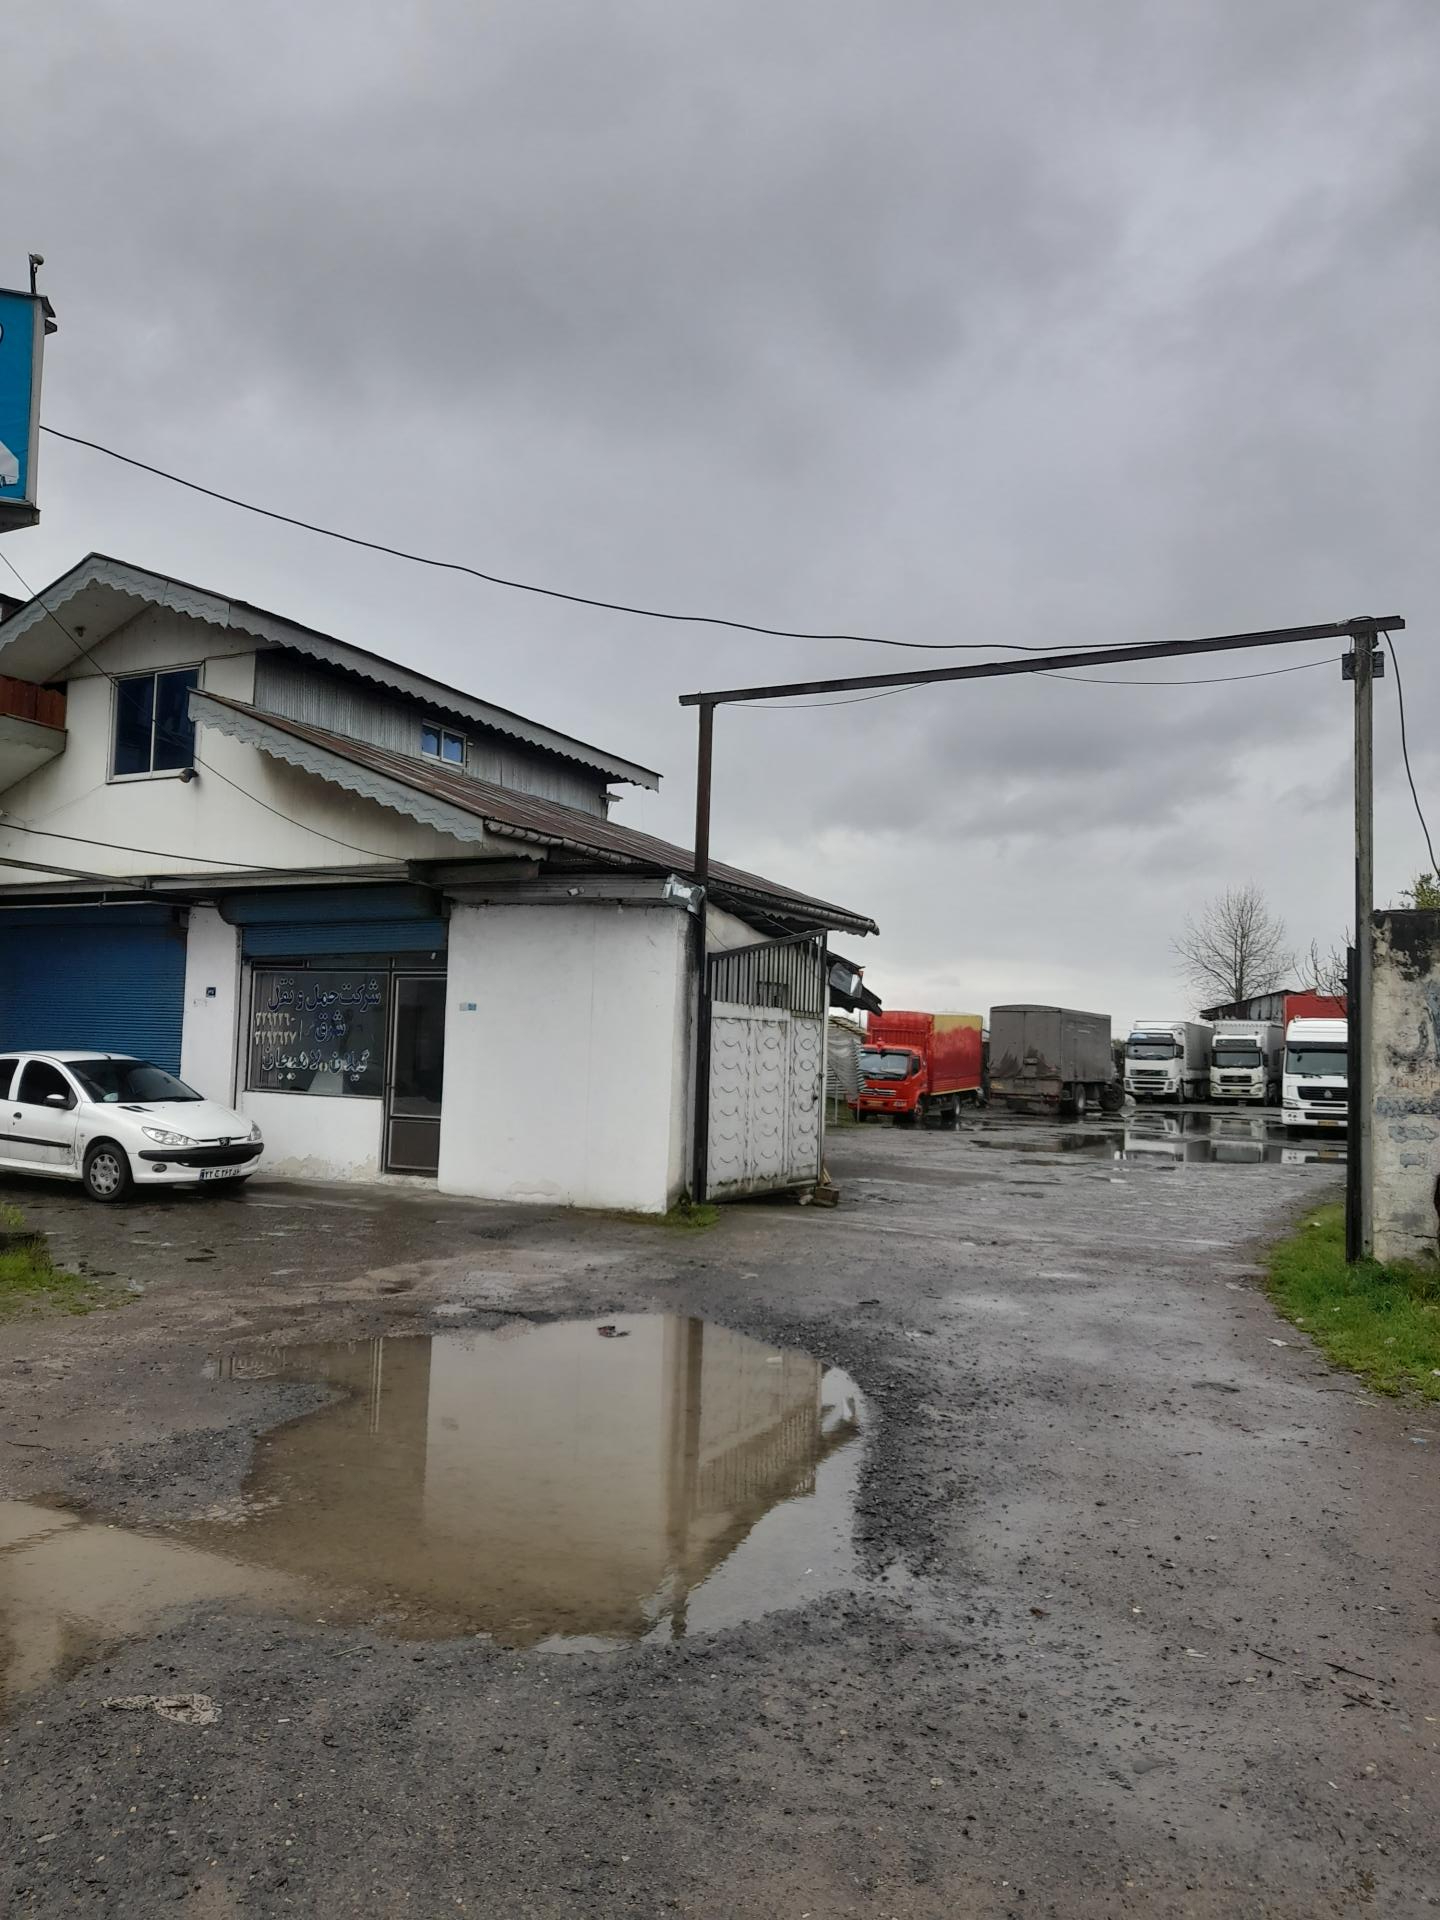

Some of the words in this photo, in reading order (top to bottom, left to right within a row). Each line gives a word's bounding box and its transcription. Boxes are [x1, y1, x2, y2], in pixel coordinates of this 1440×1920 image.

[268, 977, 295, 1012] نقل
[295, 990, 304, 1011] و
[306, 984, 340, 1011] حمل
[340, 978, 381, 1012] شرکت
[315, 1010, 347, 1042] شرق
[262, 1047, 321, 1081] لاهیجان
[328, 1049, 370, 1081] گیلان
